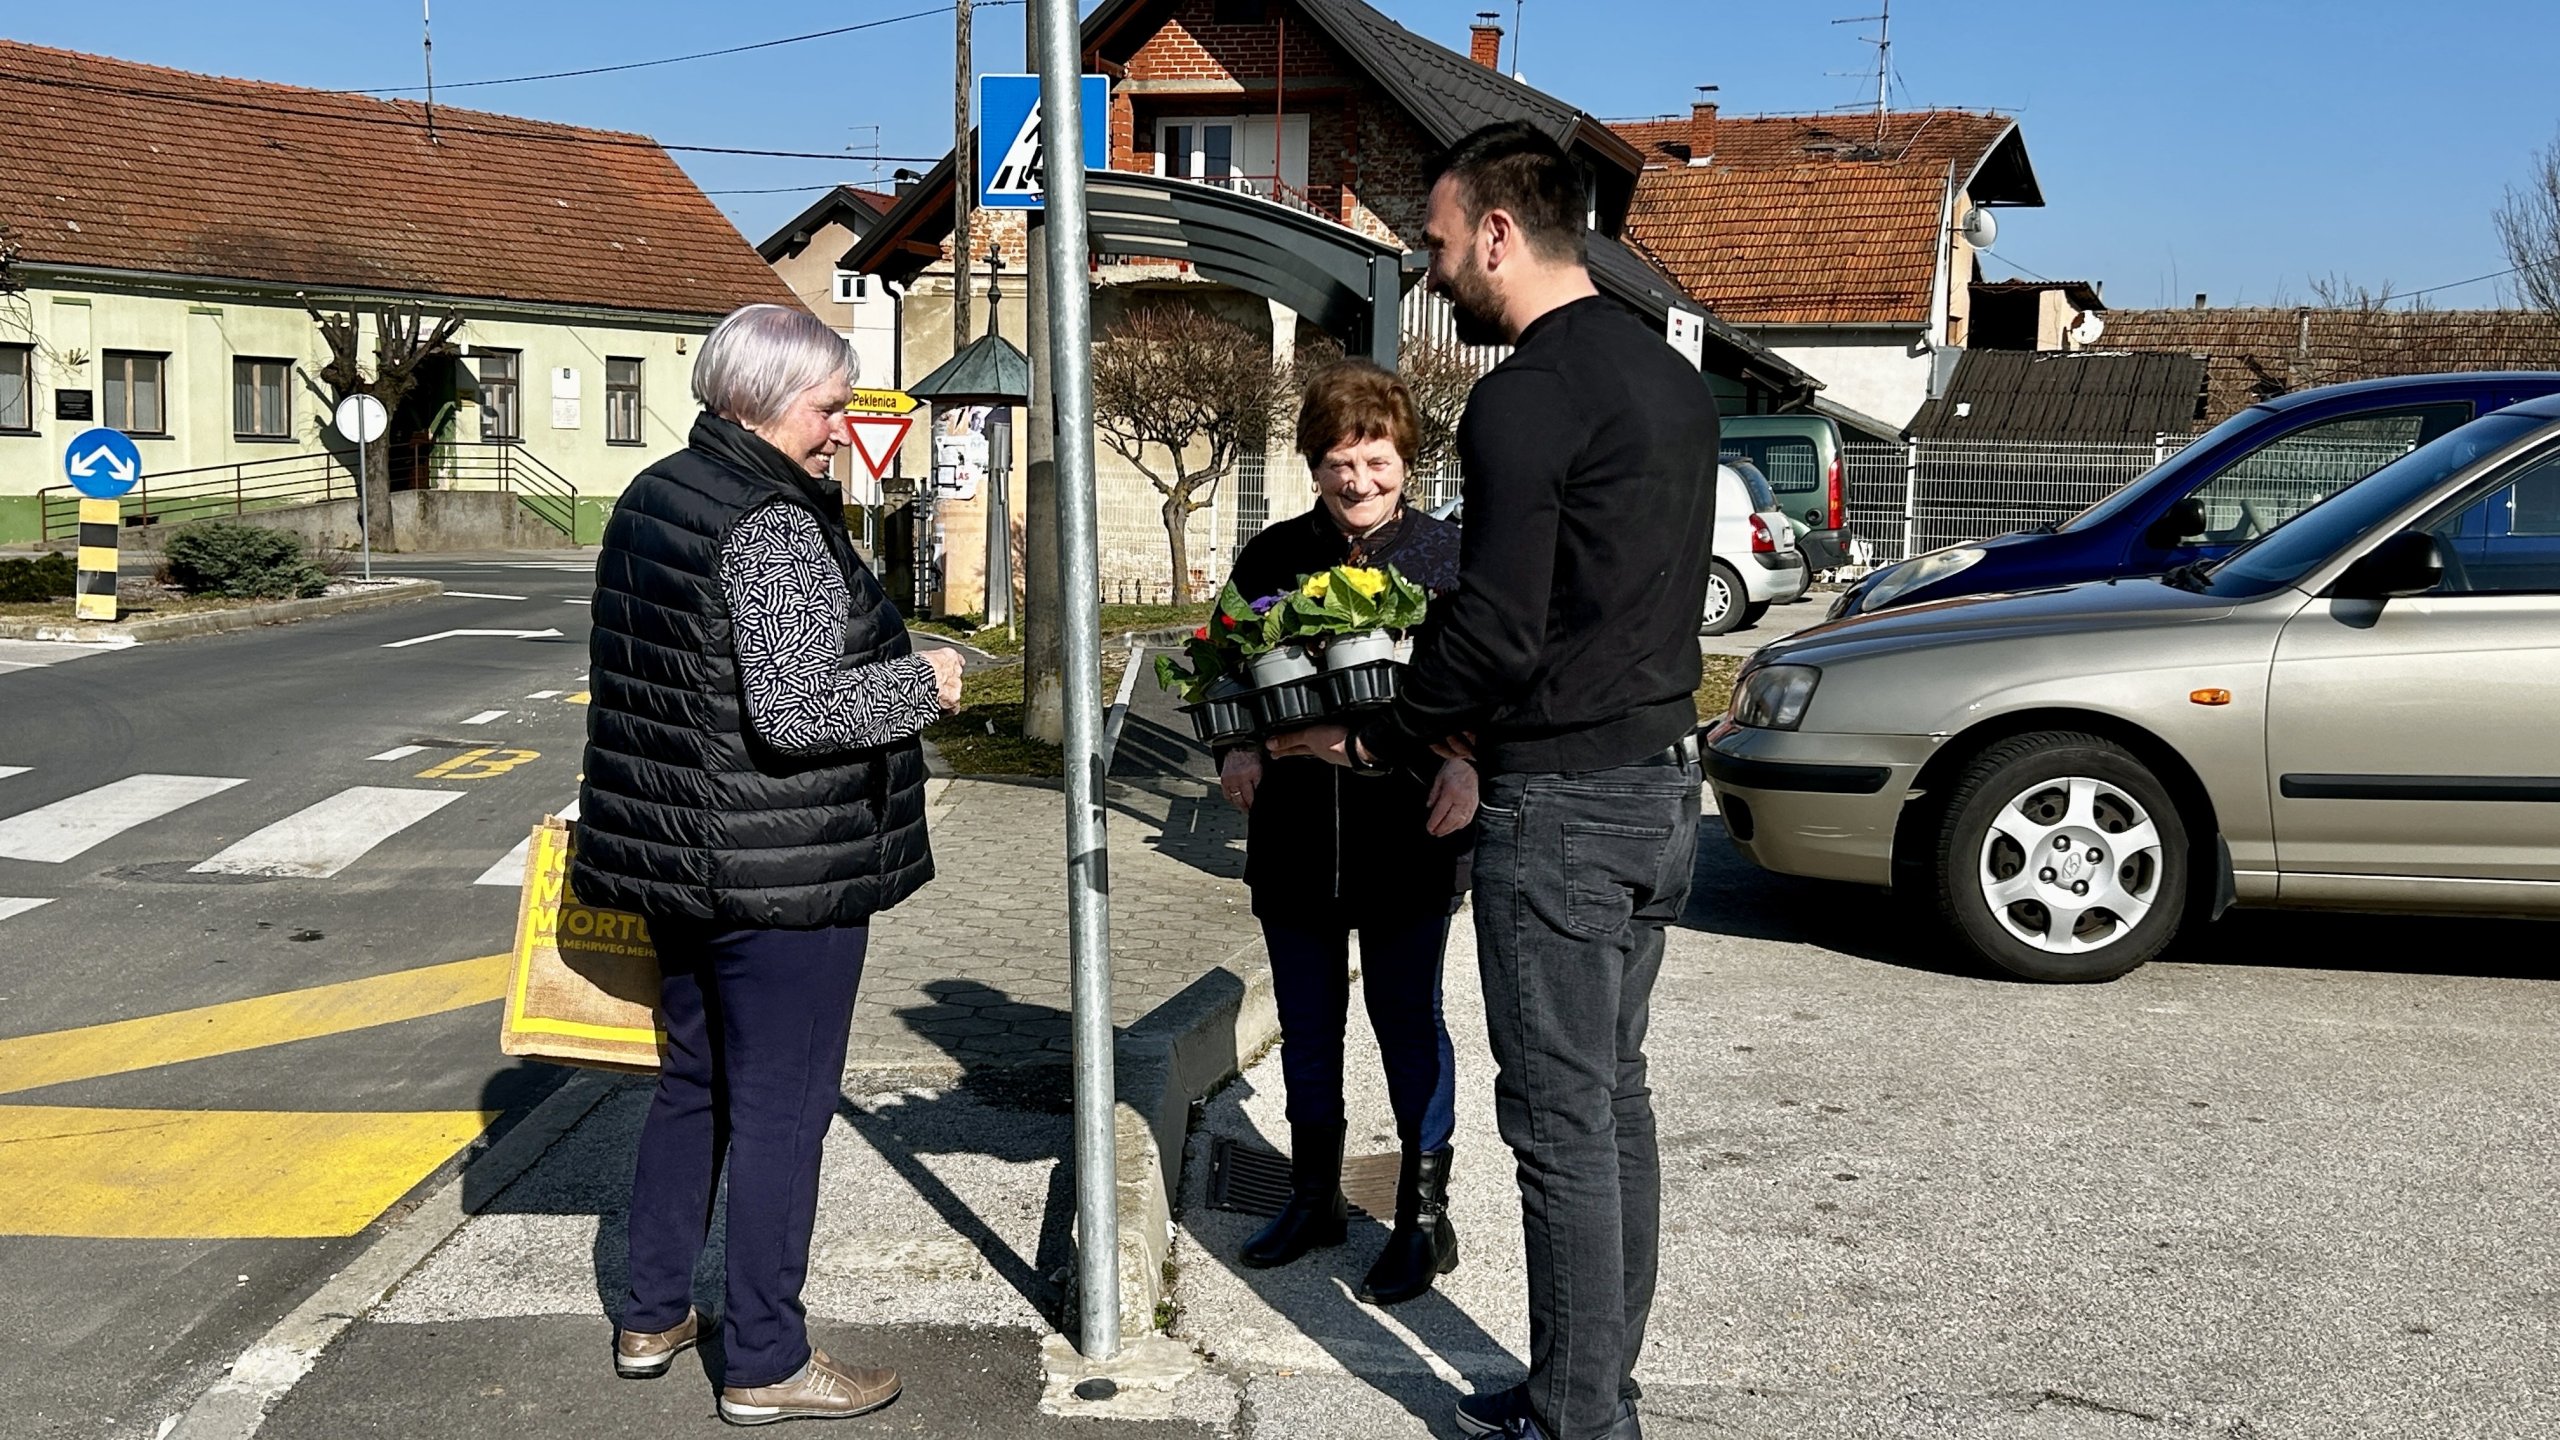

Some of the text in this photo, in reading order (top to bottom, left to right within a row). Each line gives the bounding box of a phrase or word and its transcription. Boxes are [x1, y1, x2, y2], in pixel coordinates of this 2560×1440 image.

[852, 393, 897, 408] Peklenica
[529, 906, 651, 942] WORTU
[563, 939, 625, 954] MEHRWEG
